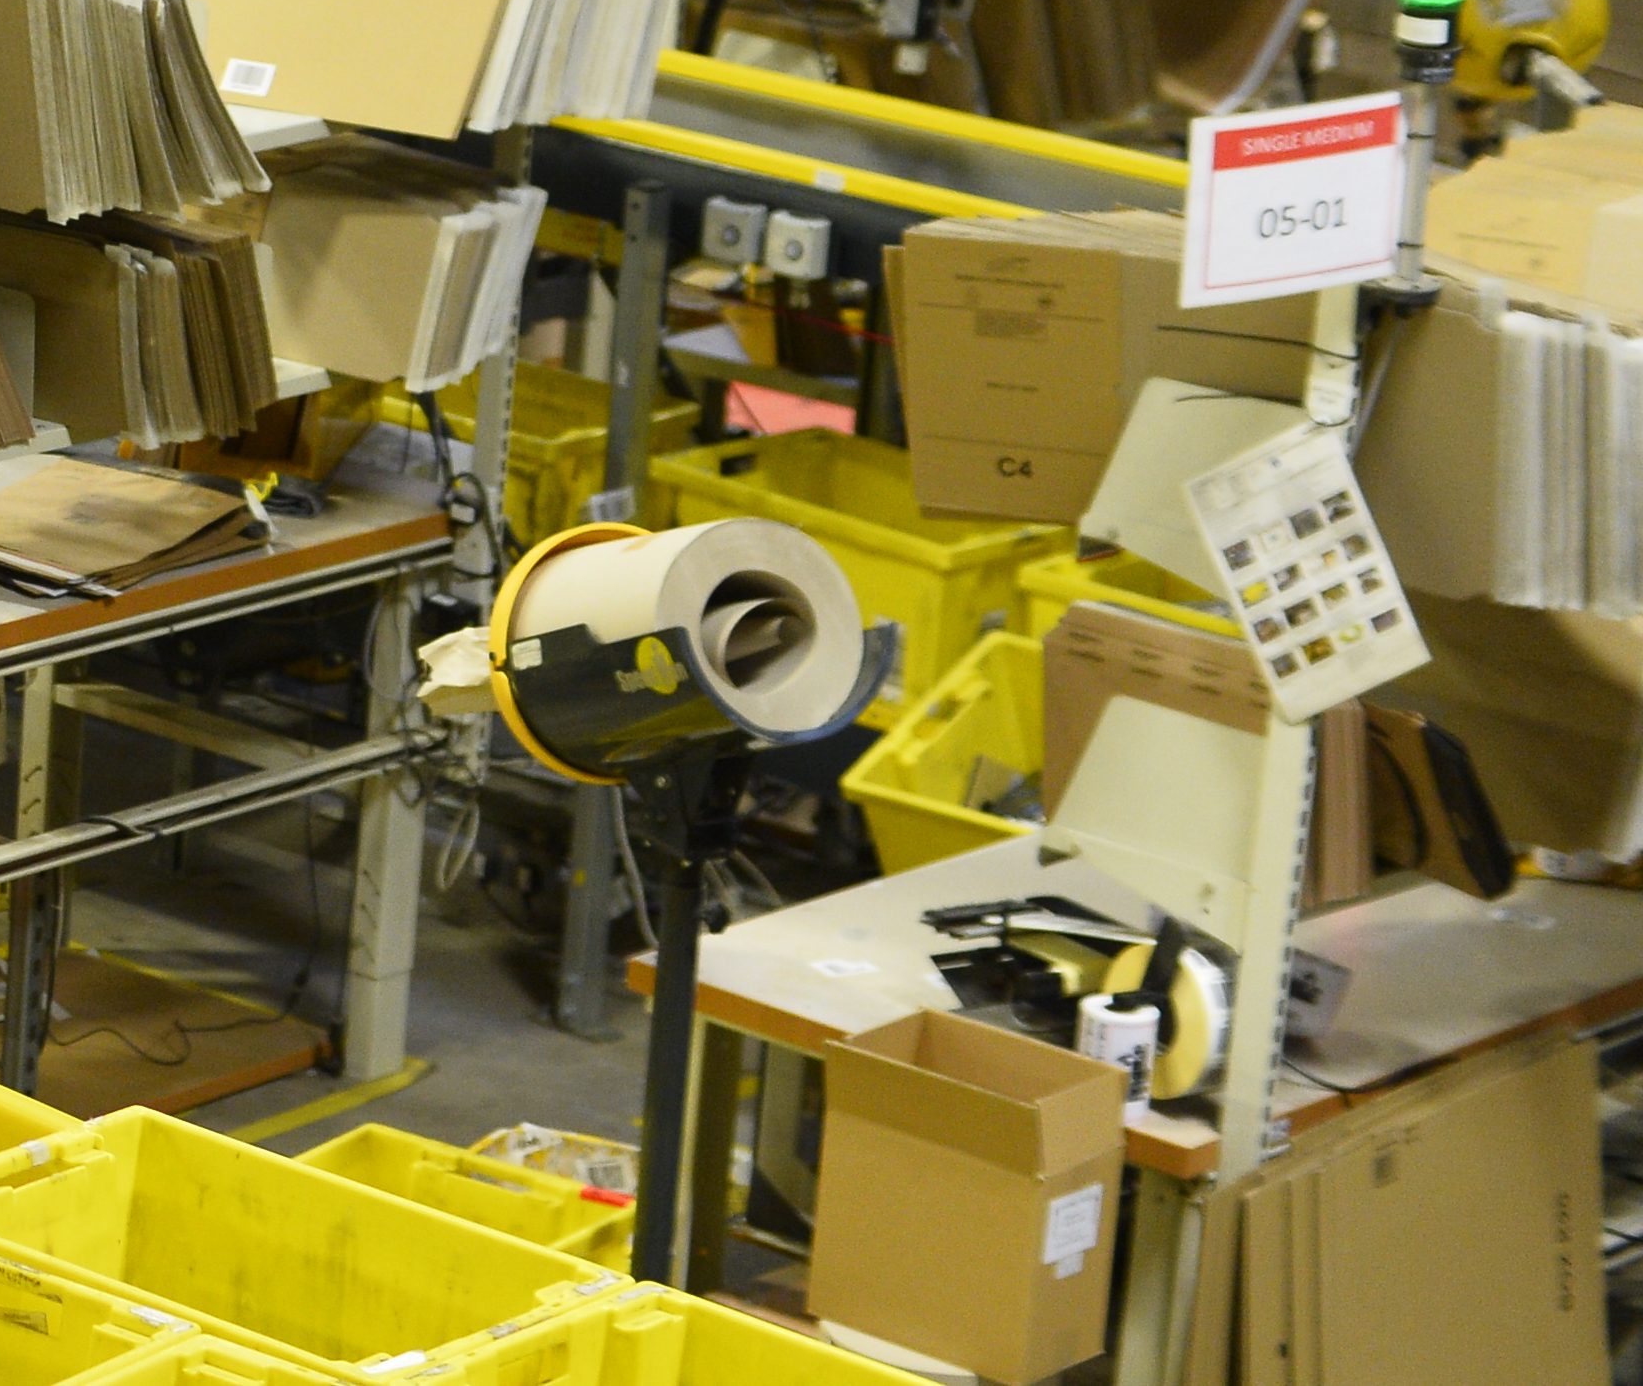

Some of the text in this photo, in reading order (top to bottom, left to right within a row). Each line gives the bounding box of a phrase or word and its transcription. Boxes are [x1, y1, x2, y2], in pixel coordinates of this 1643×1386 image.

[1240, 119, 1375, 157] SINGLE MEDIUM
[1258, 196, 1348, 239] 05-01
[997, 457, 1035, 479] C4
